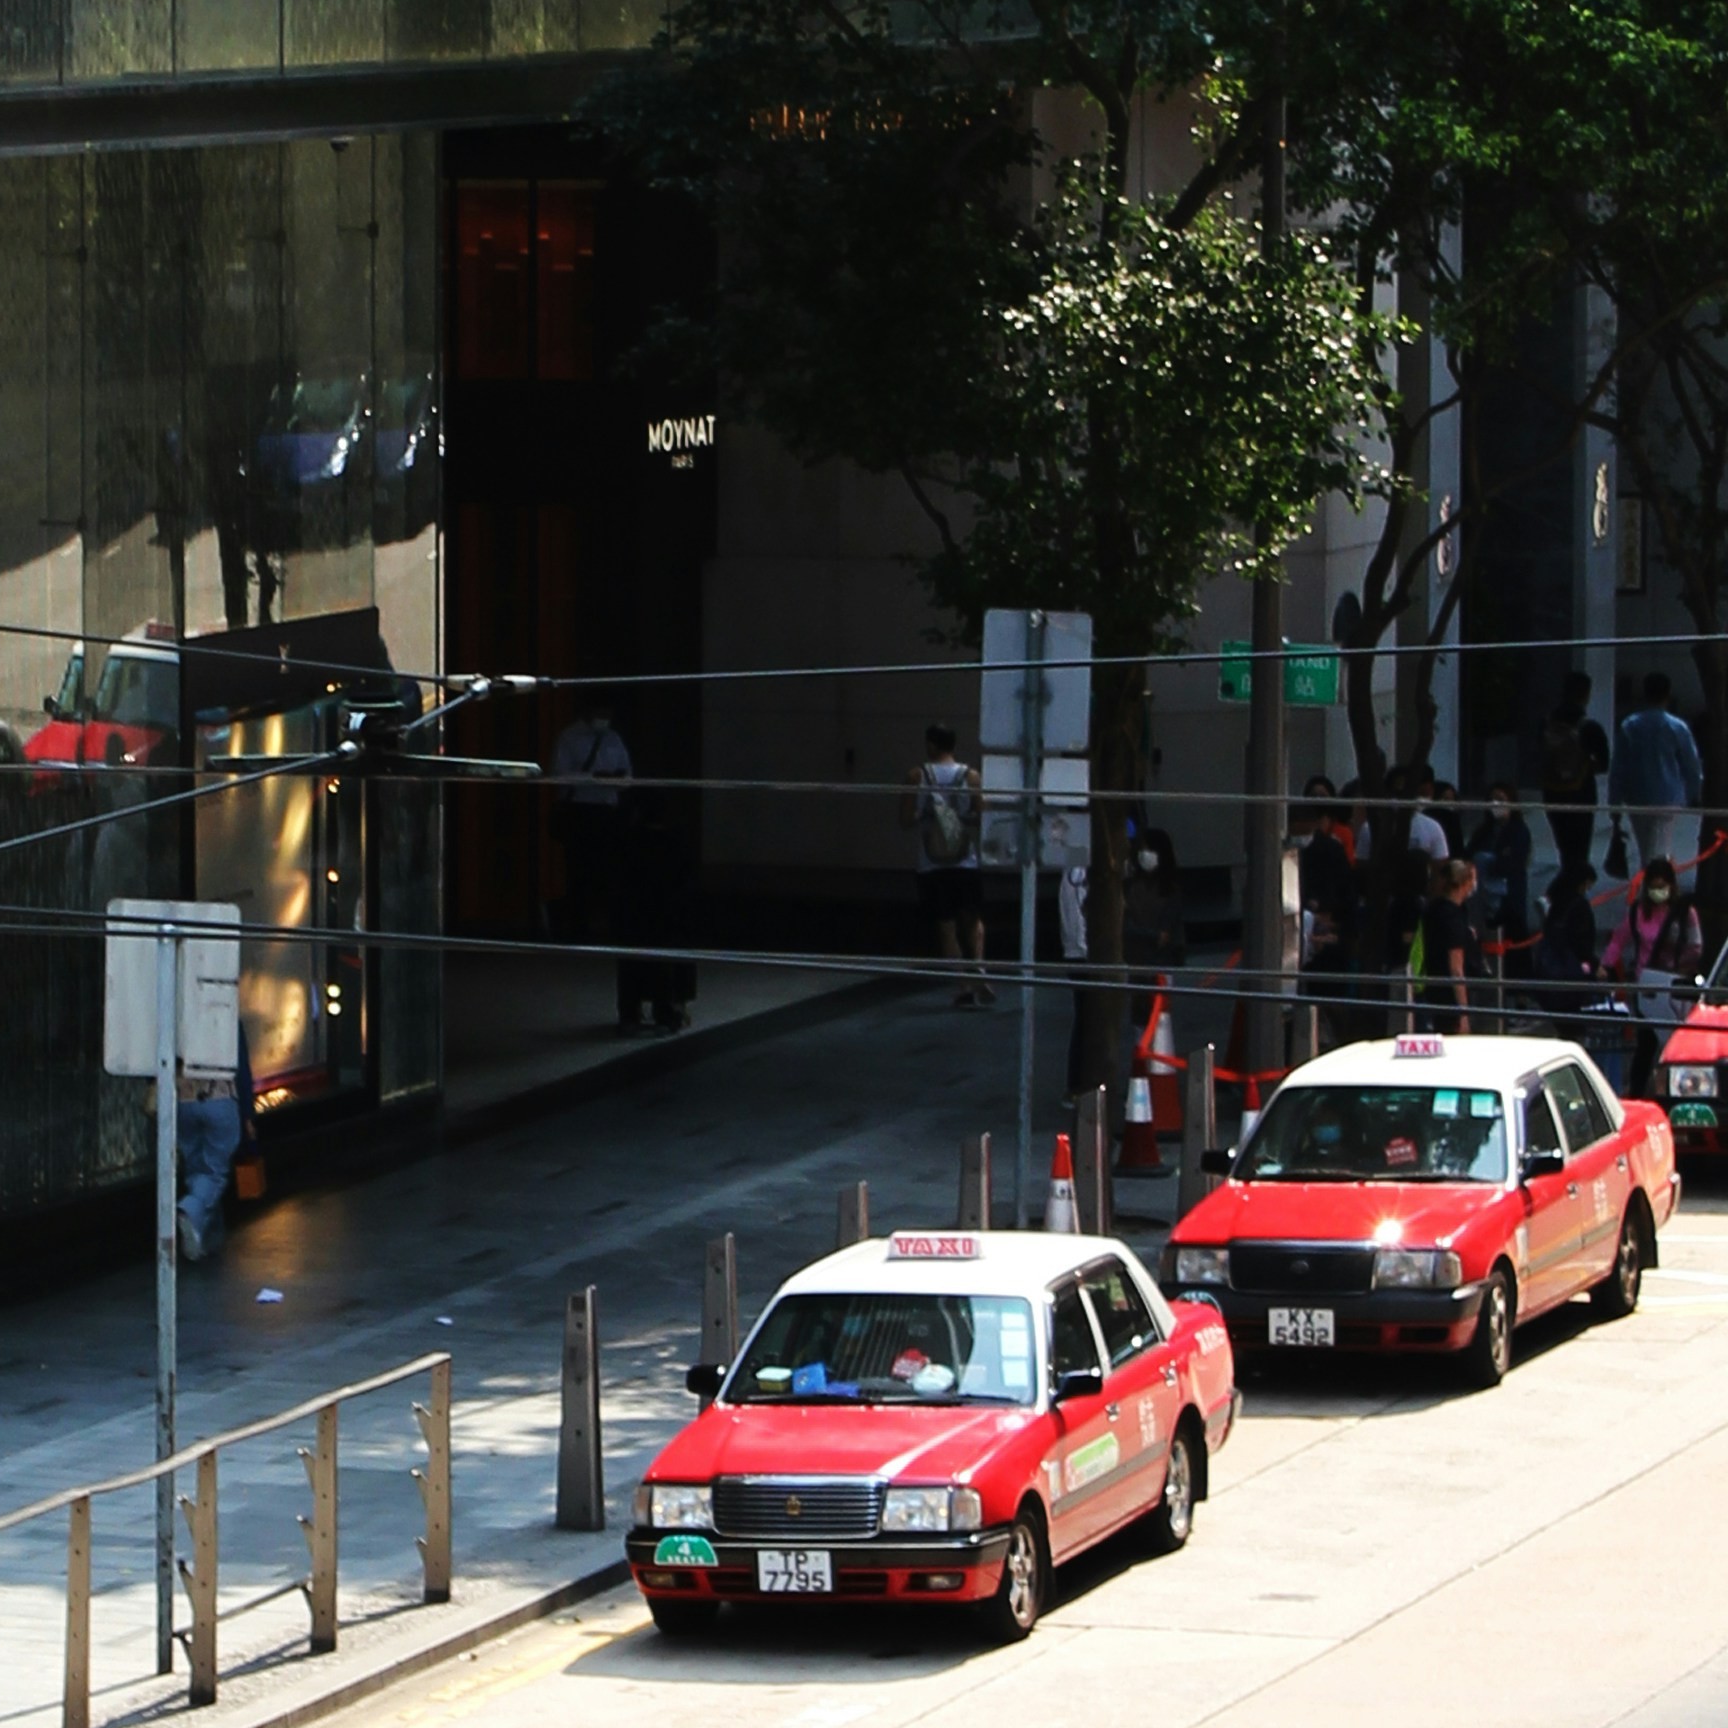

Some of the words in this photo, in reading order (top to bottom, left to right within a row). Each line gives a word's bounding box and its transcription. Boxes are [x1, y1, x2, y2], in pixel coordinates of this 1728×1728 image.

[648, 414, 716, 454] MOYNAT
[1399, 1040, 1439, 1054] TAXI
[894, 1237, 974, 1255] TAXI
[1288, 1309, 1315, 1327] KX
[678, 1542, 691, 1556] 4
[779, 1551, 808, 1573] TP
[764, 1571, 825, 1592] 7795
